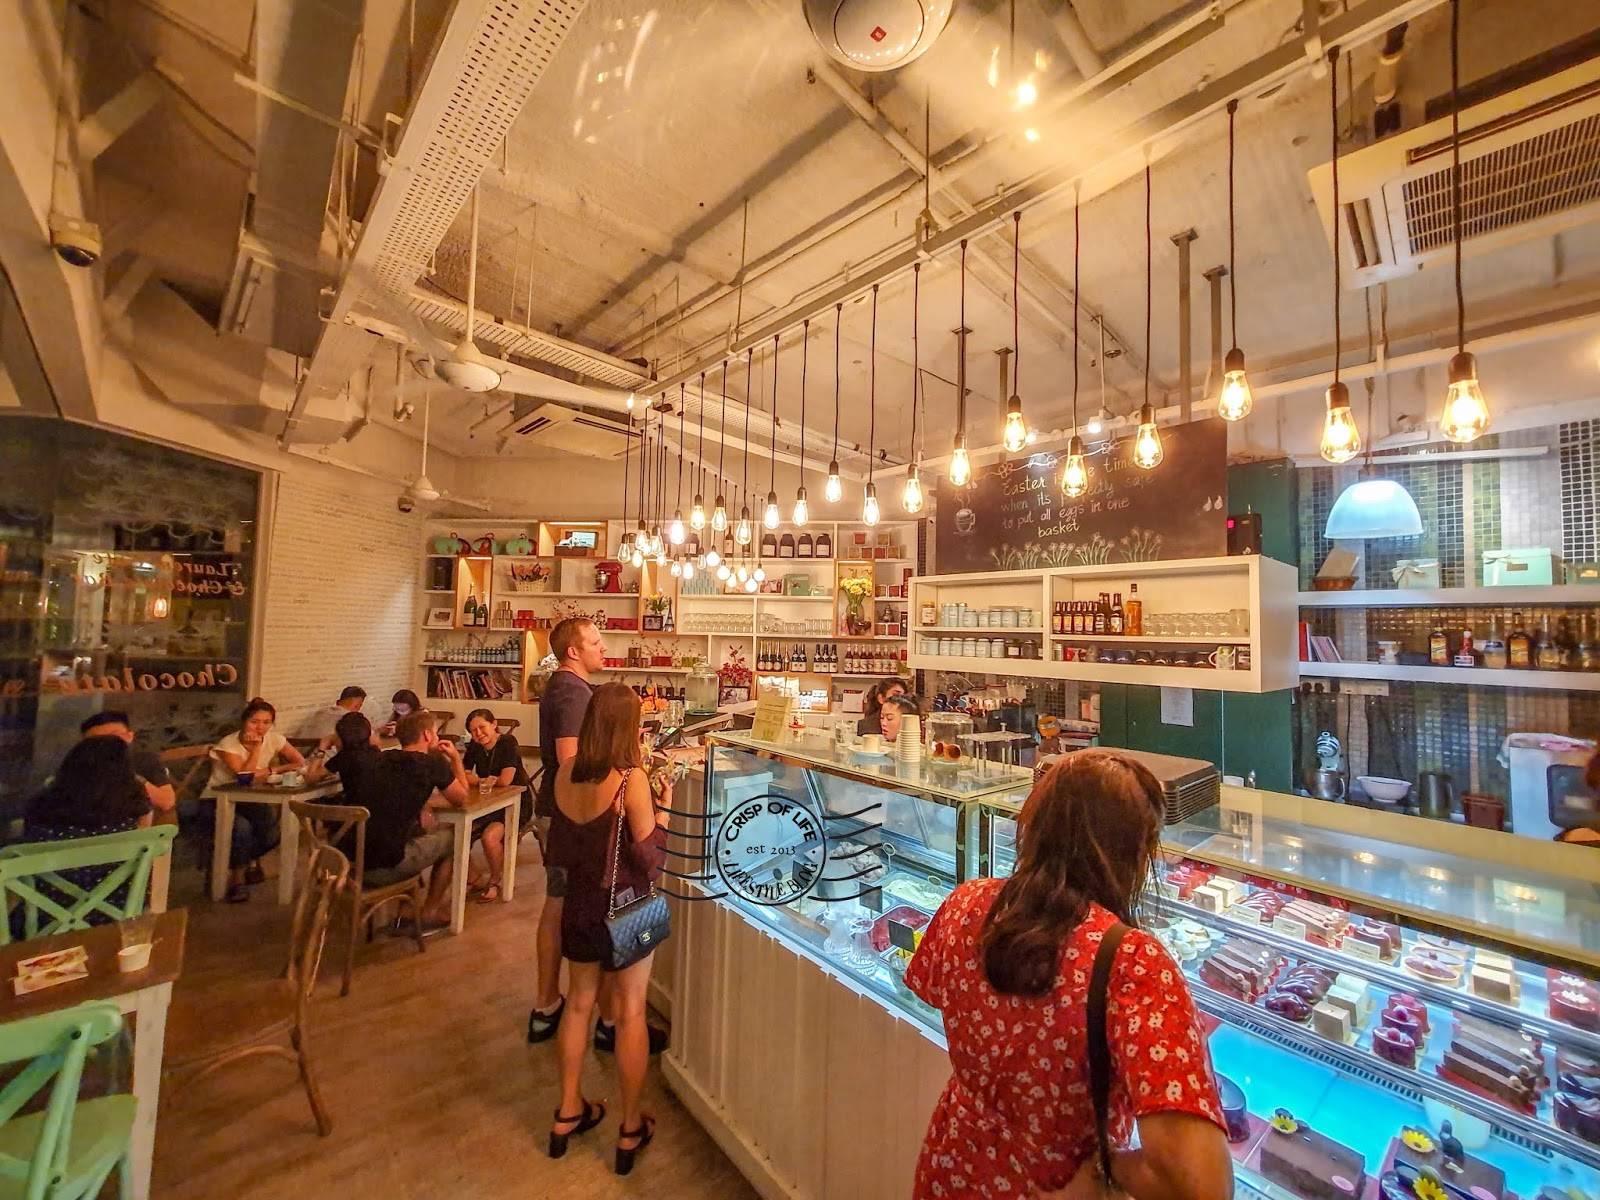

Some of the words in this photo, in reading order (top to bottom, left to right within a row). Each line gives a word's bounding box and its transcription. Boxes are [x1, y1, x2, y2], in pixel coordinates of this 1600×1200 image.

[1002, 475, 1046, 496] Easter
[1103, 457, 1134, 474] time
[1000, 499, 1029, 513] when
[1002, 517, 1013, 530] to
[1017, 510, 1035, 530] put
[1040, 508, 1051, 522] all
[1059, 503, 1085, 522] eggs
[1091, 499, 1102, 513] in
[1107, 497, 1131, 511] one
[1037, 518, 1081, 539] basket
